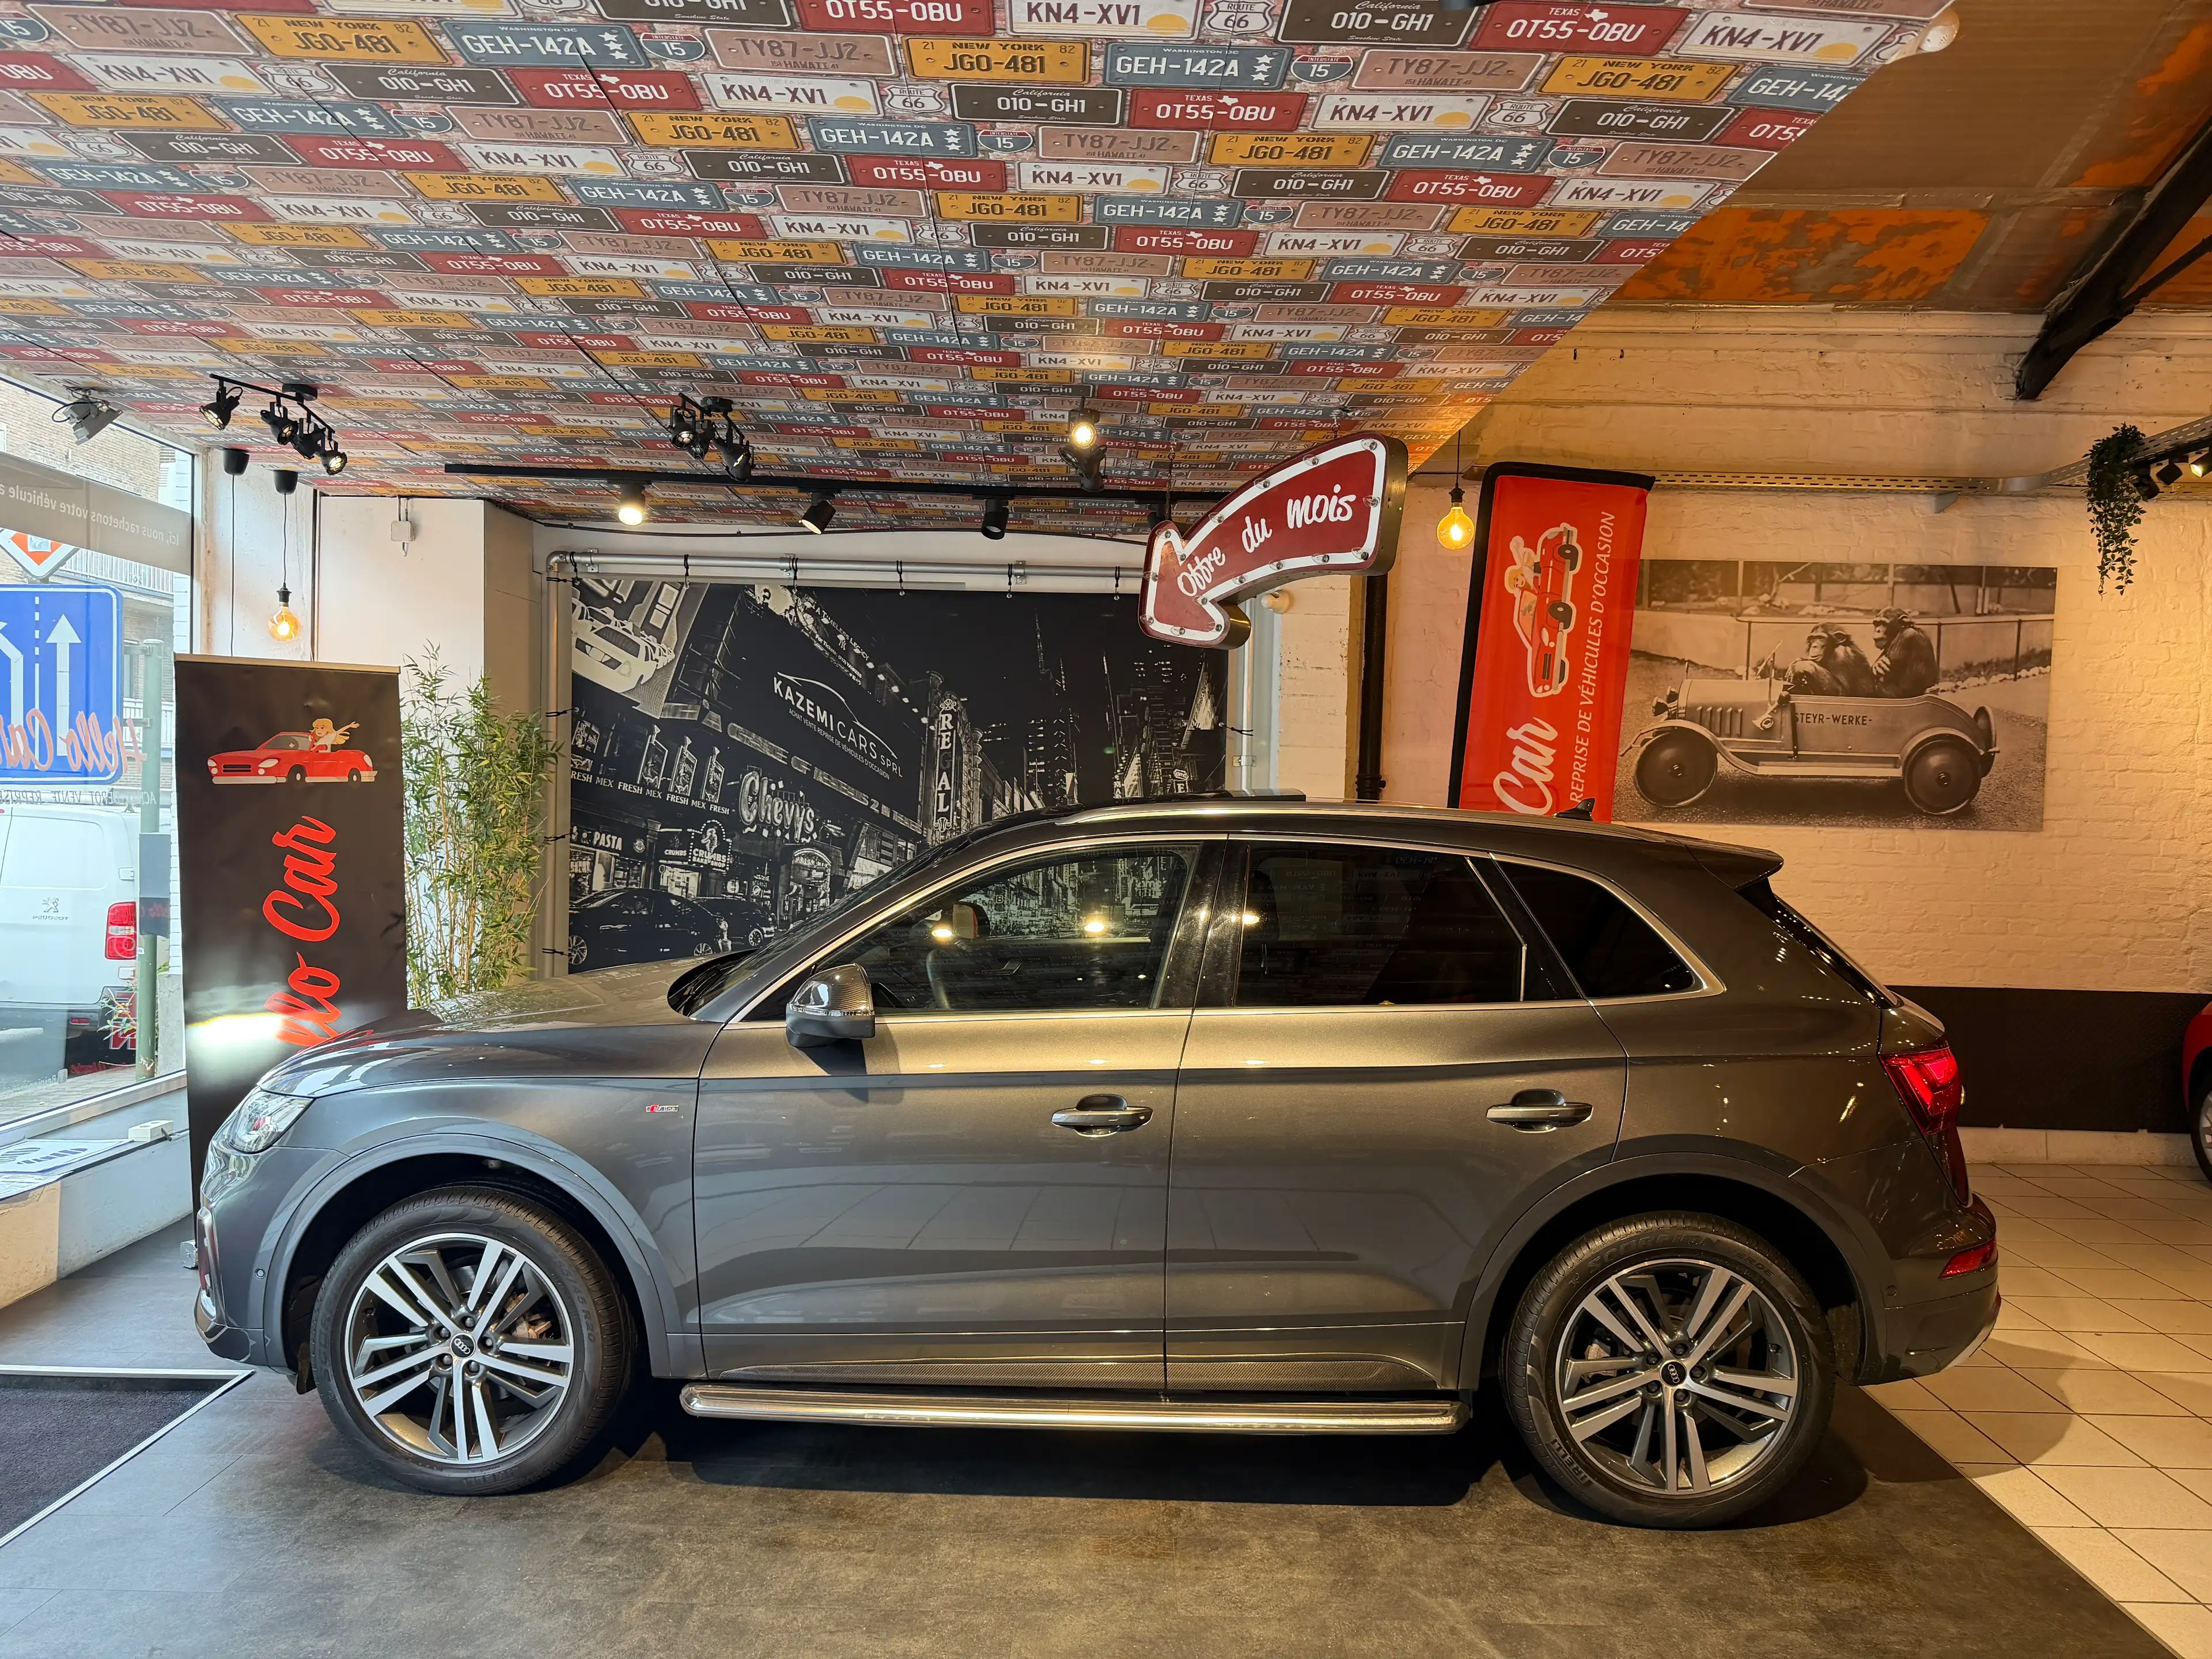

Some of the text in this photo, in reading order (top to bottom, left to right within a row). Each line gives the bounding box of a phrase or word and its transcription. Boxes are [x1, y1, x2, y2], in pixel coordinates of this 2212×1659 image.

[1226, 3, 1256, 12] ROUTE
[1353, 1, 1424, 14] California
[1546, 8, 1582, 17] TEXAS
[282, 20, 382, 30] NEW YORK
[1222, 13, 1251, 28] 66
[459, 34, 597, 56] GEH-142A
[661, 42, 687, 56] 15
[922, 41, 934, 50] 21
[998, 43, 1044, 51] YORK
[1059, 45, 1075, 53] 82
[1115, 55, 1243, 77] GEH-142A
[1307, 64, 1331, 77] 15
[1601, 60, 1698, 69] NEW YORK
[383, 67, 451, 78] California
[280, 75, 315, 87] 66
[1012, 88, 1071, 99] California
[1745, 78, 1856, 101] GEH-14
[900, 97, 926, 108] 66
[1620, 104, 1686, 115] California
[229, 108, 358, 126] GEH-142A
[411, 117, 438, 128] 15
[1500, 111, 1530, 123] 66
[819, 128, 934, 146] GEH-142A
[995, 137, 1014, 148] 15
[1389, 143, 1509, 161] GEH-142A
[44, 169, 165, 184] GEH-142A
[578, 187, 688, 202] GEH-142A
[1103, 204, 1205, 219] GEH-142A
[1094, 304, 1179, 315] GEH-142A
[1177, 484, 1357, 597] Offre du mois
[1569, 512, 1615, 804] REPRISE DE VÉHICULES D'OCCASION
[773, 676, 903, 778] KAZEMI CARS SPRL
[789, 708, 891, 781] ACHAT VENTE REPRISE DE VÉHICULES D'OCCASION
[1493, 717, 1559, 816] Car
[570, 770, 730, 815] RESH MEX FRESH MEX FRESH MEX FRESH
[593, 831, 623, 851] PASTA
[664, 849, 687, 857] CRUMBS
[692, 848, 728, 863] CRUMBS
[263, 815, 340, 942] Car
